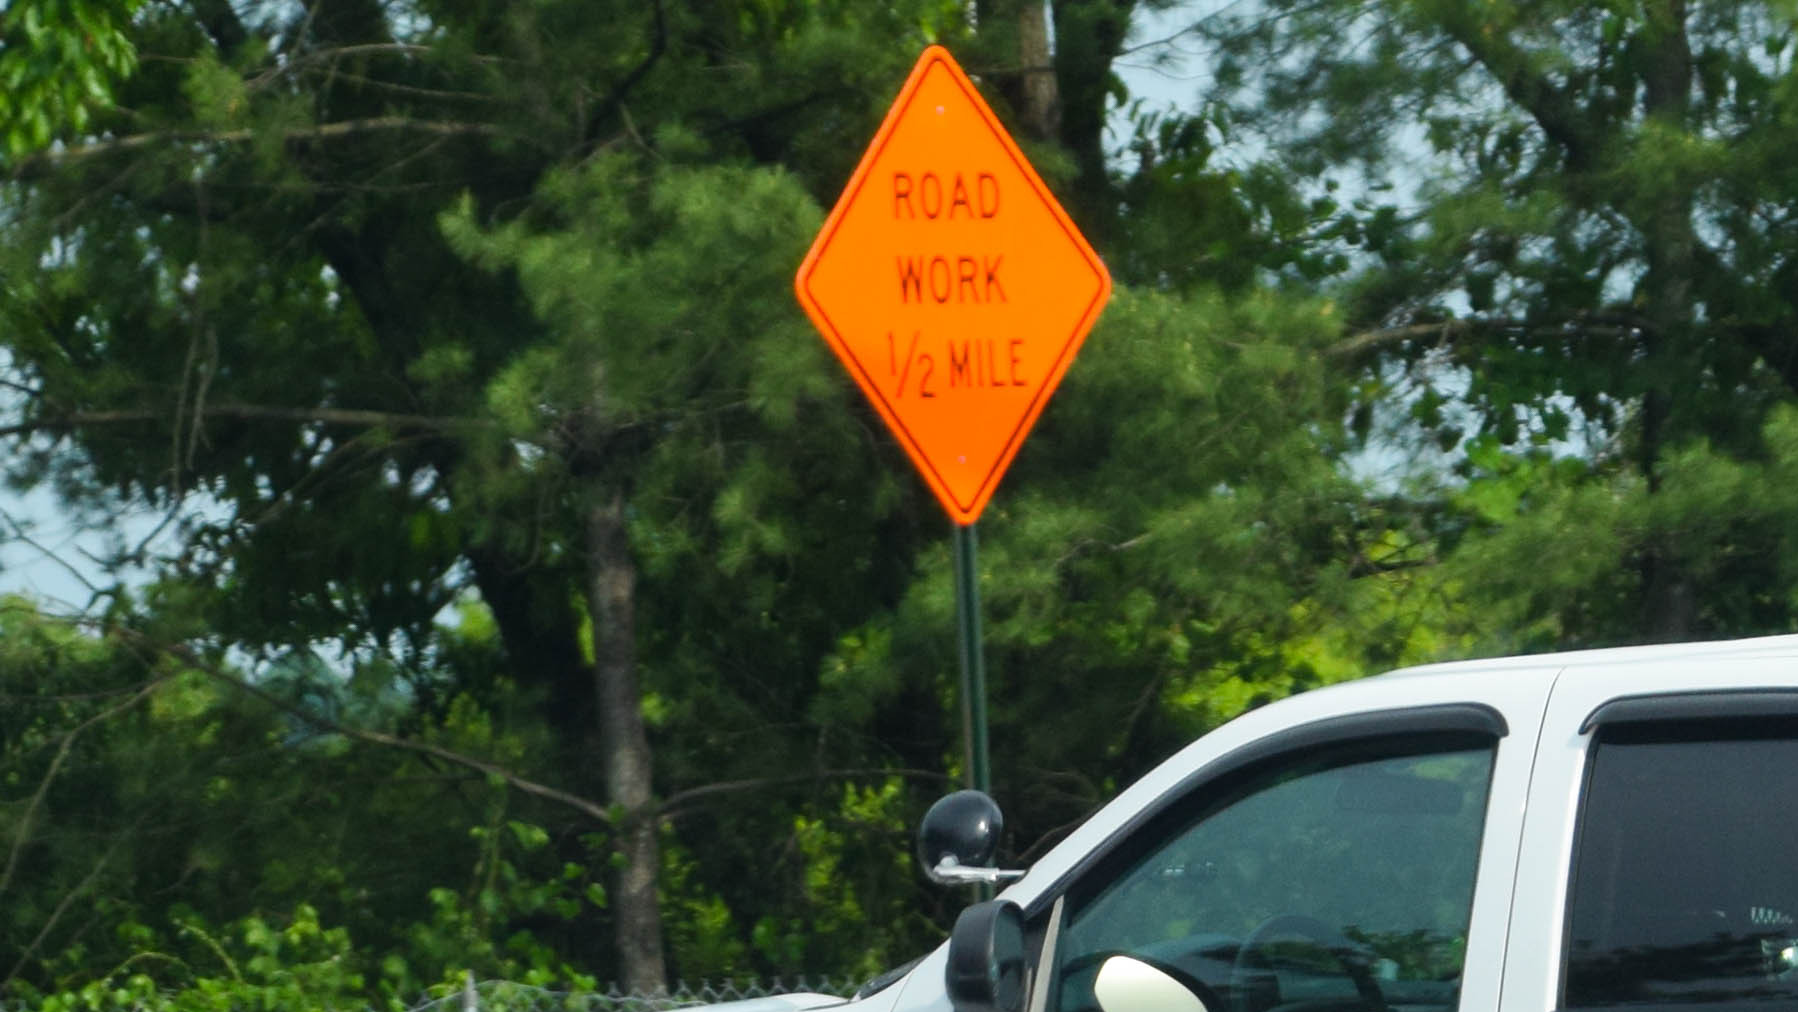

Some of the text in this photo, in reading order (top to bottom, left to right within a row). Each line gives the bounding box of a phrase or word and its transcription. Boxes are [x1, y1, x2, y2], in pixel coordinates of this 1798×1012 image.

[893, 172, 1001, 220] ROAD
[896, 255, 1008, 304] WORK
[949, 338, 1029, 389] MILE
